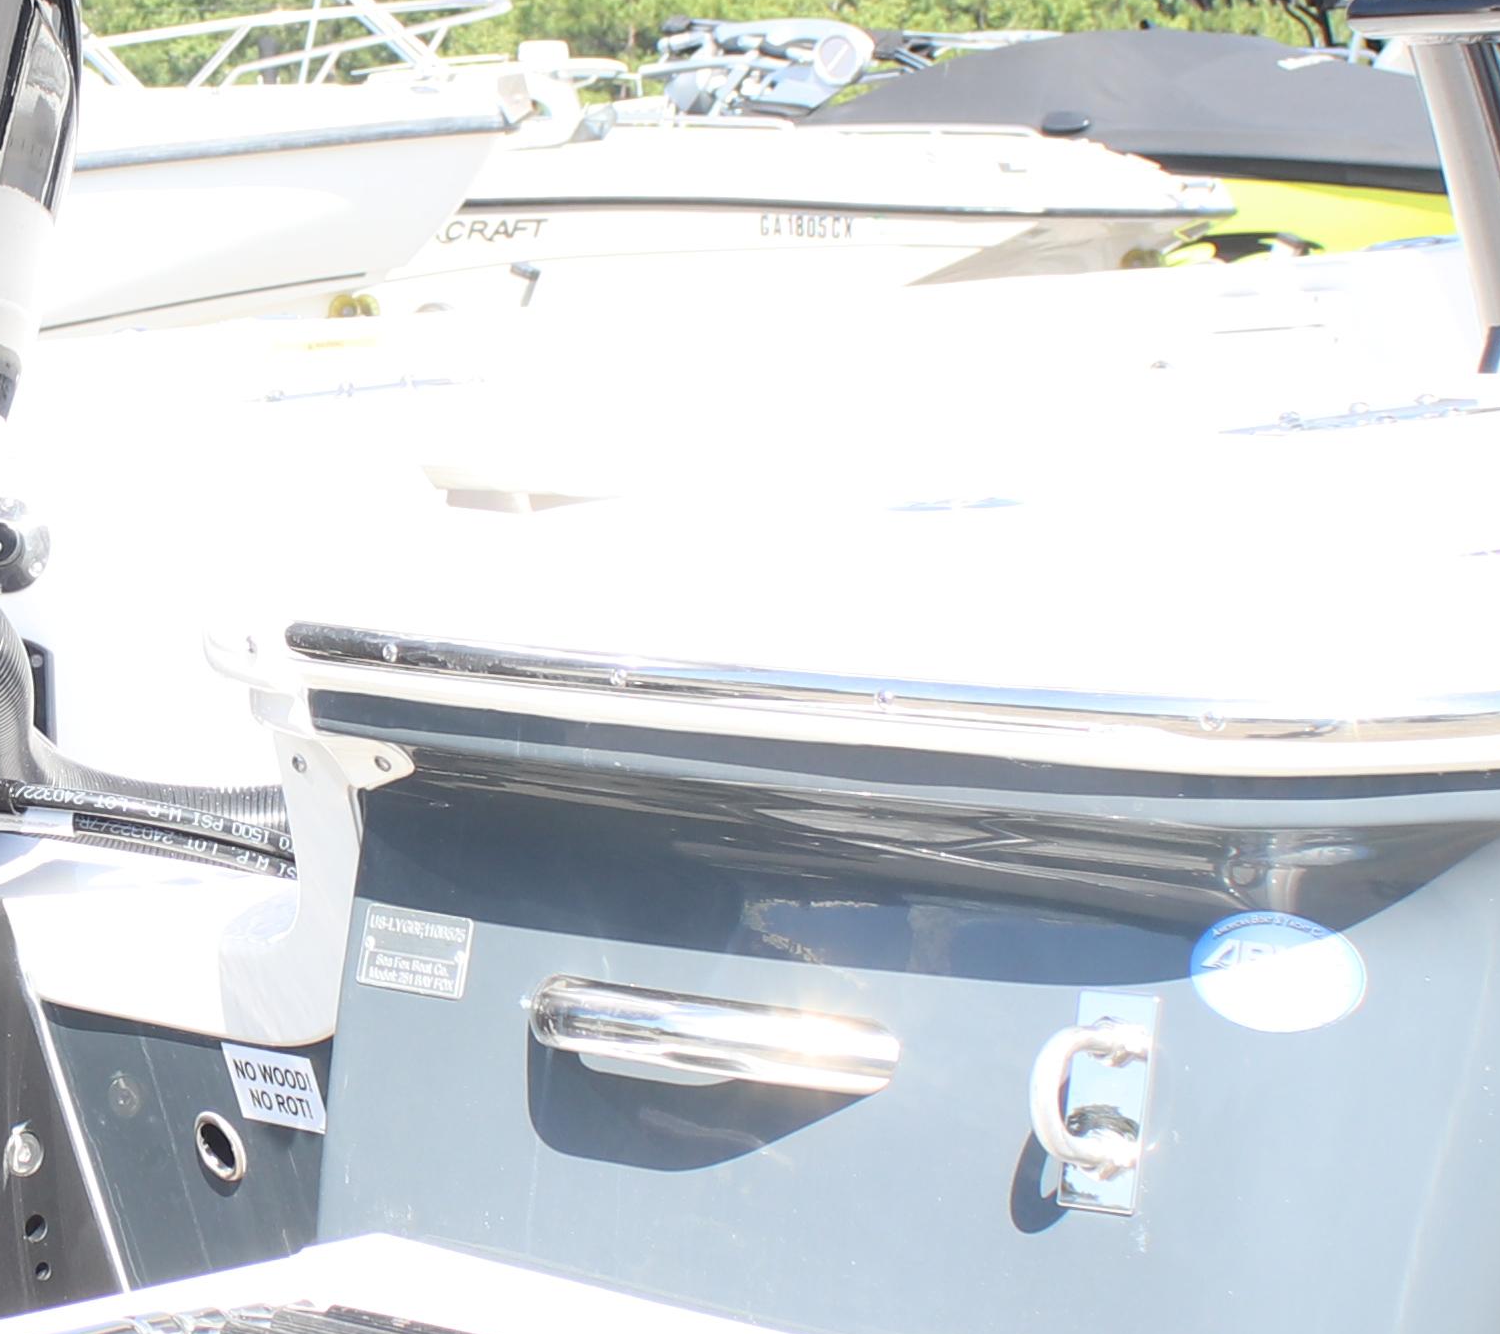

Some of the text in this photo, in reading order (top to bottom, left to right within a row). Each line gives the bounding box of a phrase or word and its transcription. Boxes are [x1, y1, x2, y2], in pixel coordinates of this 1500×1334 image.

[436, 218, 549, 244] CRAFT
[760, 214, 854, 240] GA 1805 CX
[192, 811, 224, 832] PSI
[231, 821, 270, 845] 1500
[277, 862, 297, 880] SI
[233, 1058, 313, 1092] NO WOOD!
[249, 1088, 314, 1120] NO ROT!
